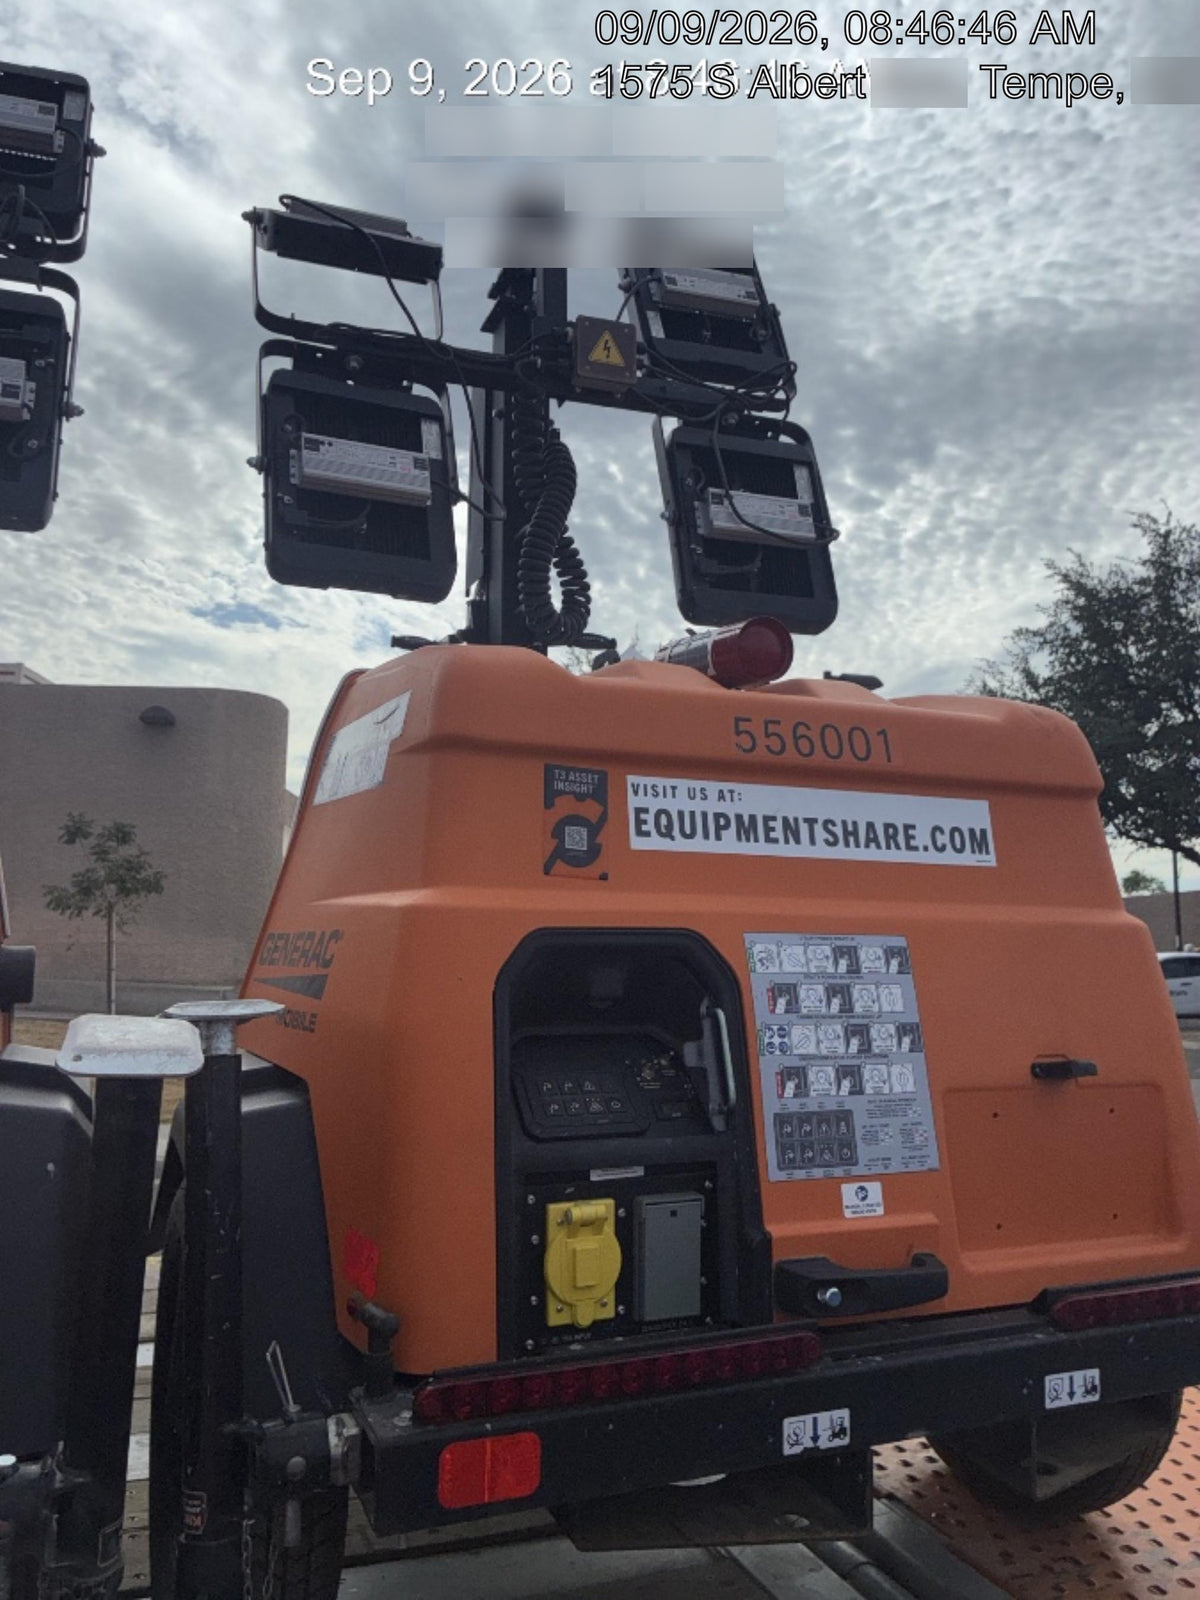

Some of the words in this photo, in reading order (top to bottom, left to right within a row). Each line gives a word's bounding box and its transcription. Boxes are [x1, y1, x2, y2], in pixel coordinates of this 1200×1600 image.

[733, 716, 894, 763] 556001
[554, 769, 566, 780] T3
[568, 771, 599, 784] ASSET
[554, 781, 594, 794] INSIGHT
[631, 782, 678, 799] VISIT
[687, 786, 708, 801] US
[717, 788, 742, 803] AT:
[633, 806, 991, 856] EQUIPMENTSHARE.COM
[259, 929, 343, 969] GENERAC
